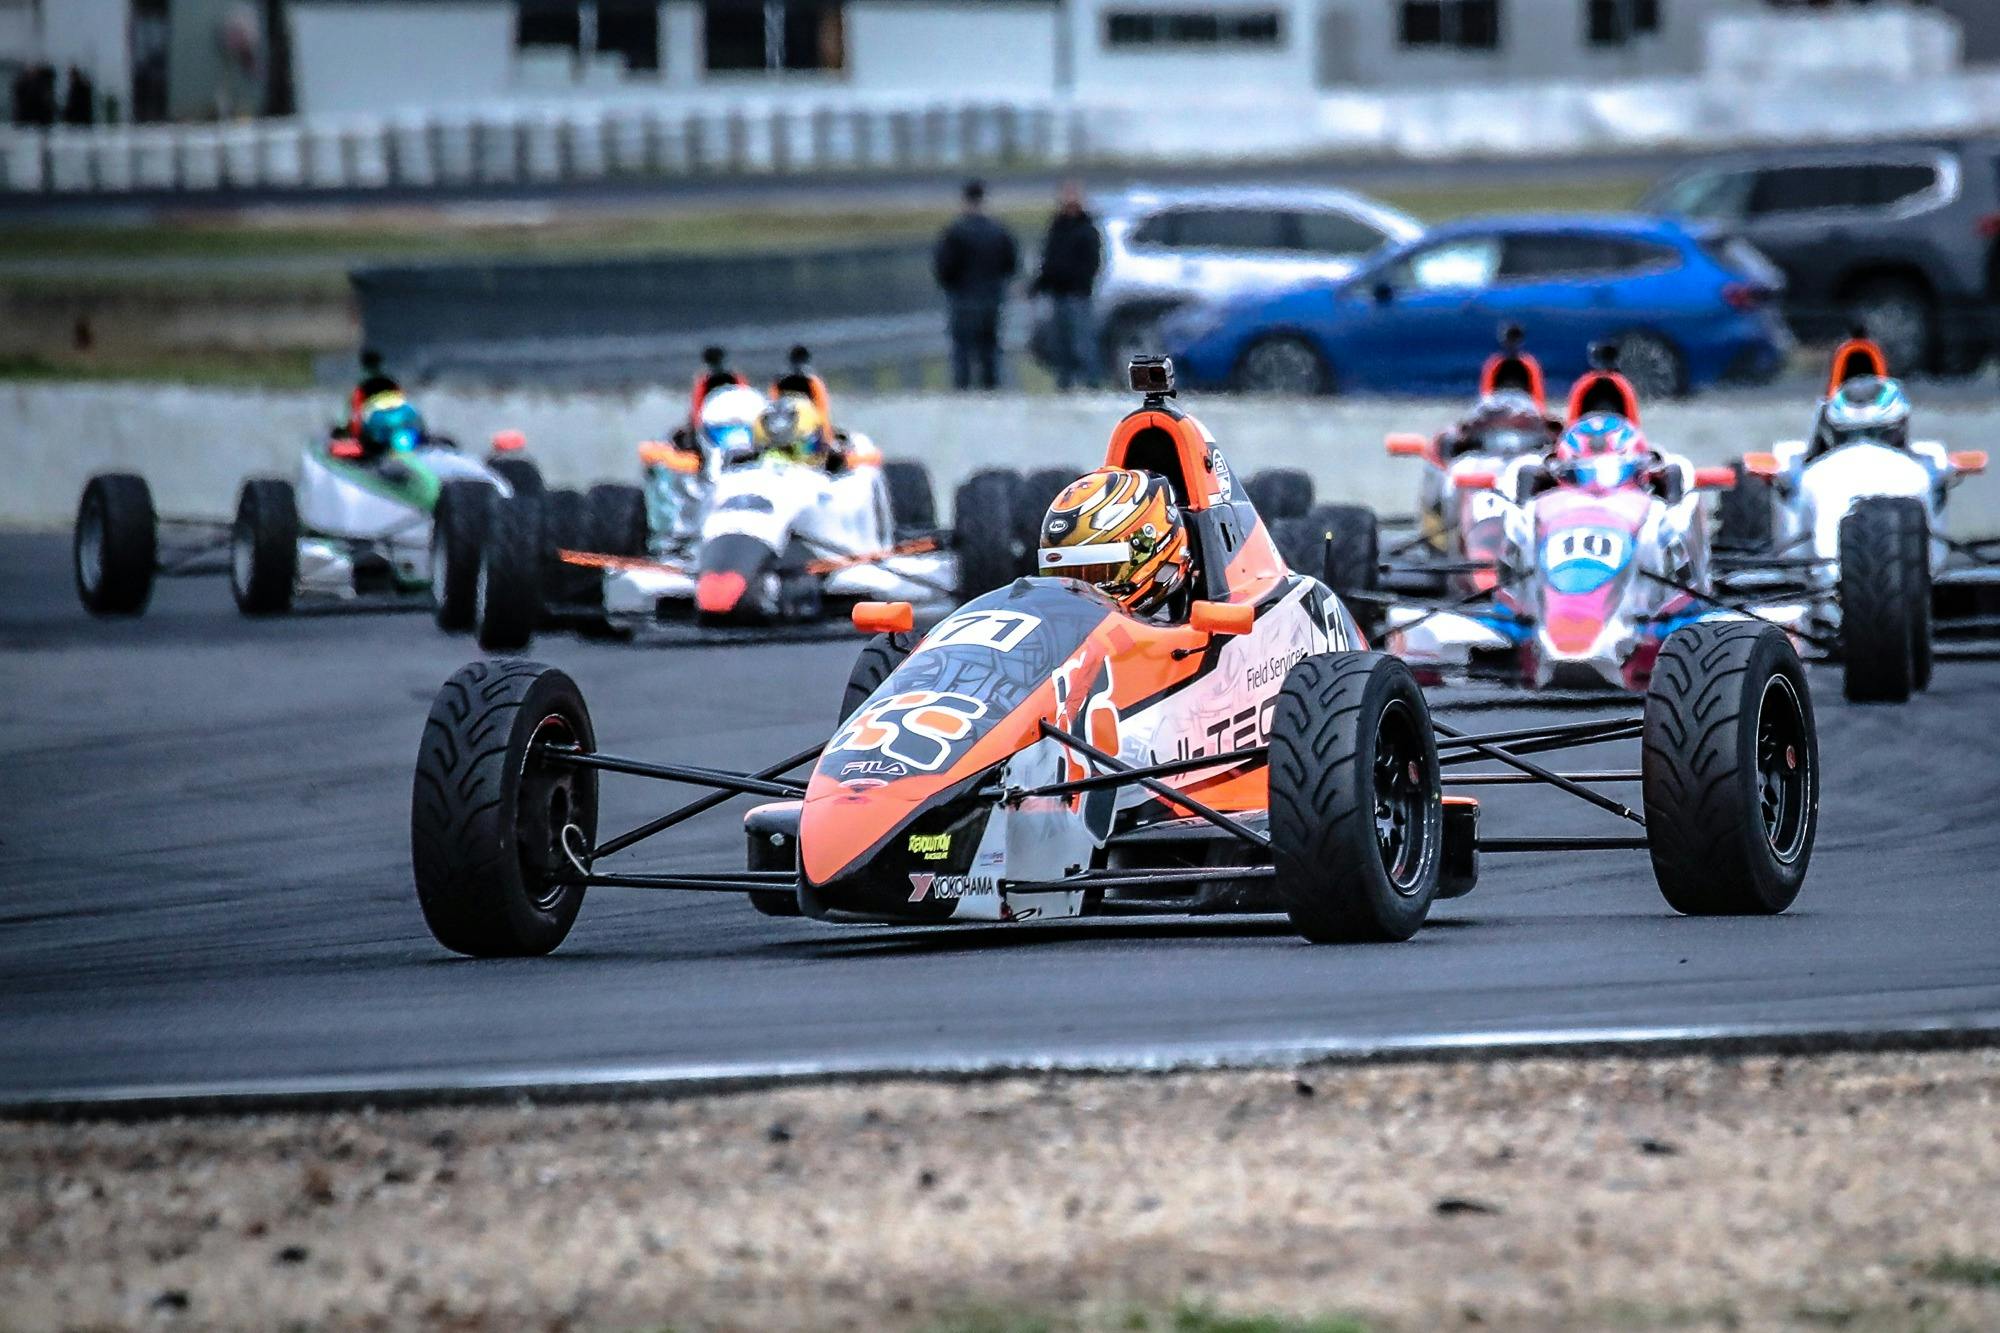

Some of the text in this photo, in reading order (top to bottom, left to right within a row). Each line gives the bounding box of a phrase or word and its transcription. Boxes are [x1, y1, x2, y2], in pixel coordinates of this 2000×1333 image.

[1562, 535, 1612, 556] 10
[939, 615, 1025, 642] 71
[1246, 660, 1268, 692] Field
[840, 760, 907, 775] FILA
[933, 876, 994, 899] YOKOHAMA
